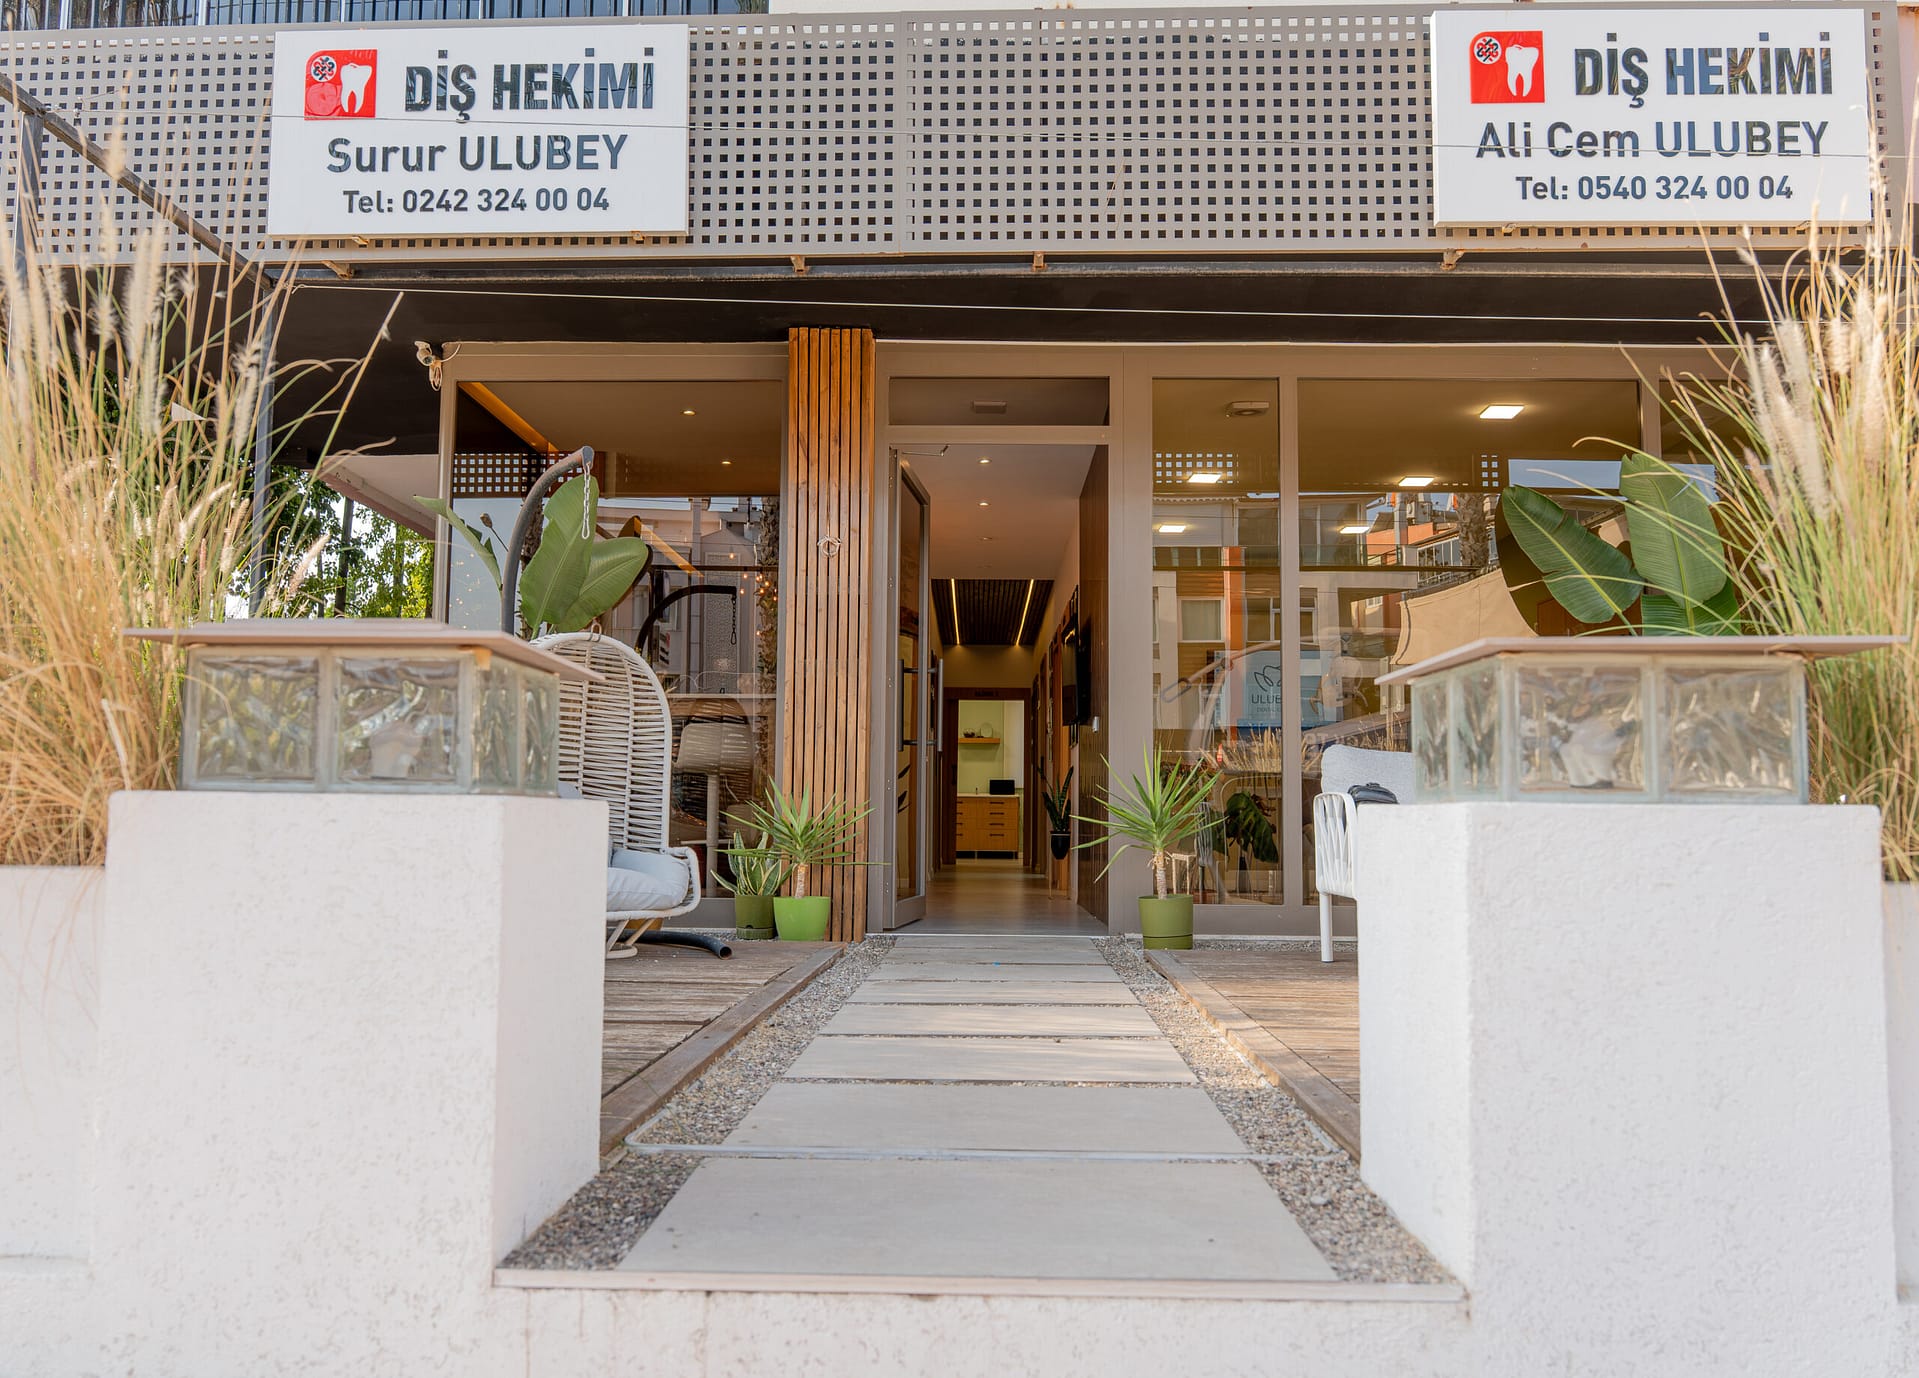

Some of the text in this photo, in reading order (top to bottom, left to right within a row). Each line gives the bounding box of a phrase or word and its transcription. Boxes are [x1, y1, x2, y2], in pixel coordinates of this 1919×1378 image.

[405, 47, 654, 122] DİŞ HEKİMİ
[1575, 32, 1832, 108] DİŞ HEKİMİ
[327, 134, 628, 172] Surur ULUBEY
[1476, 121, 1828, 158] Ali Cem ULUBEY
[343, 187, 609, 213] Tel: 0242 324 00 04
[1516, 175, 1792, 200] Tel: 0540 324 00 04
